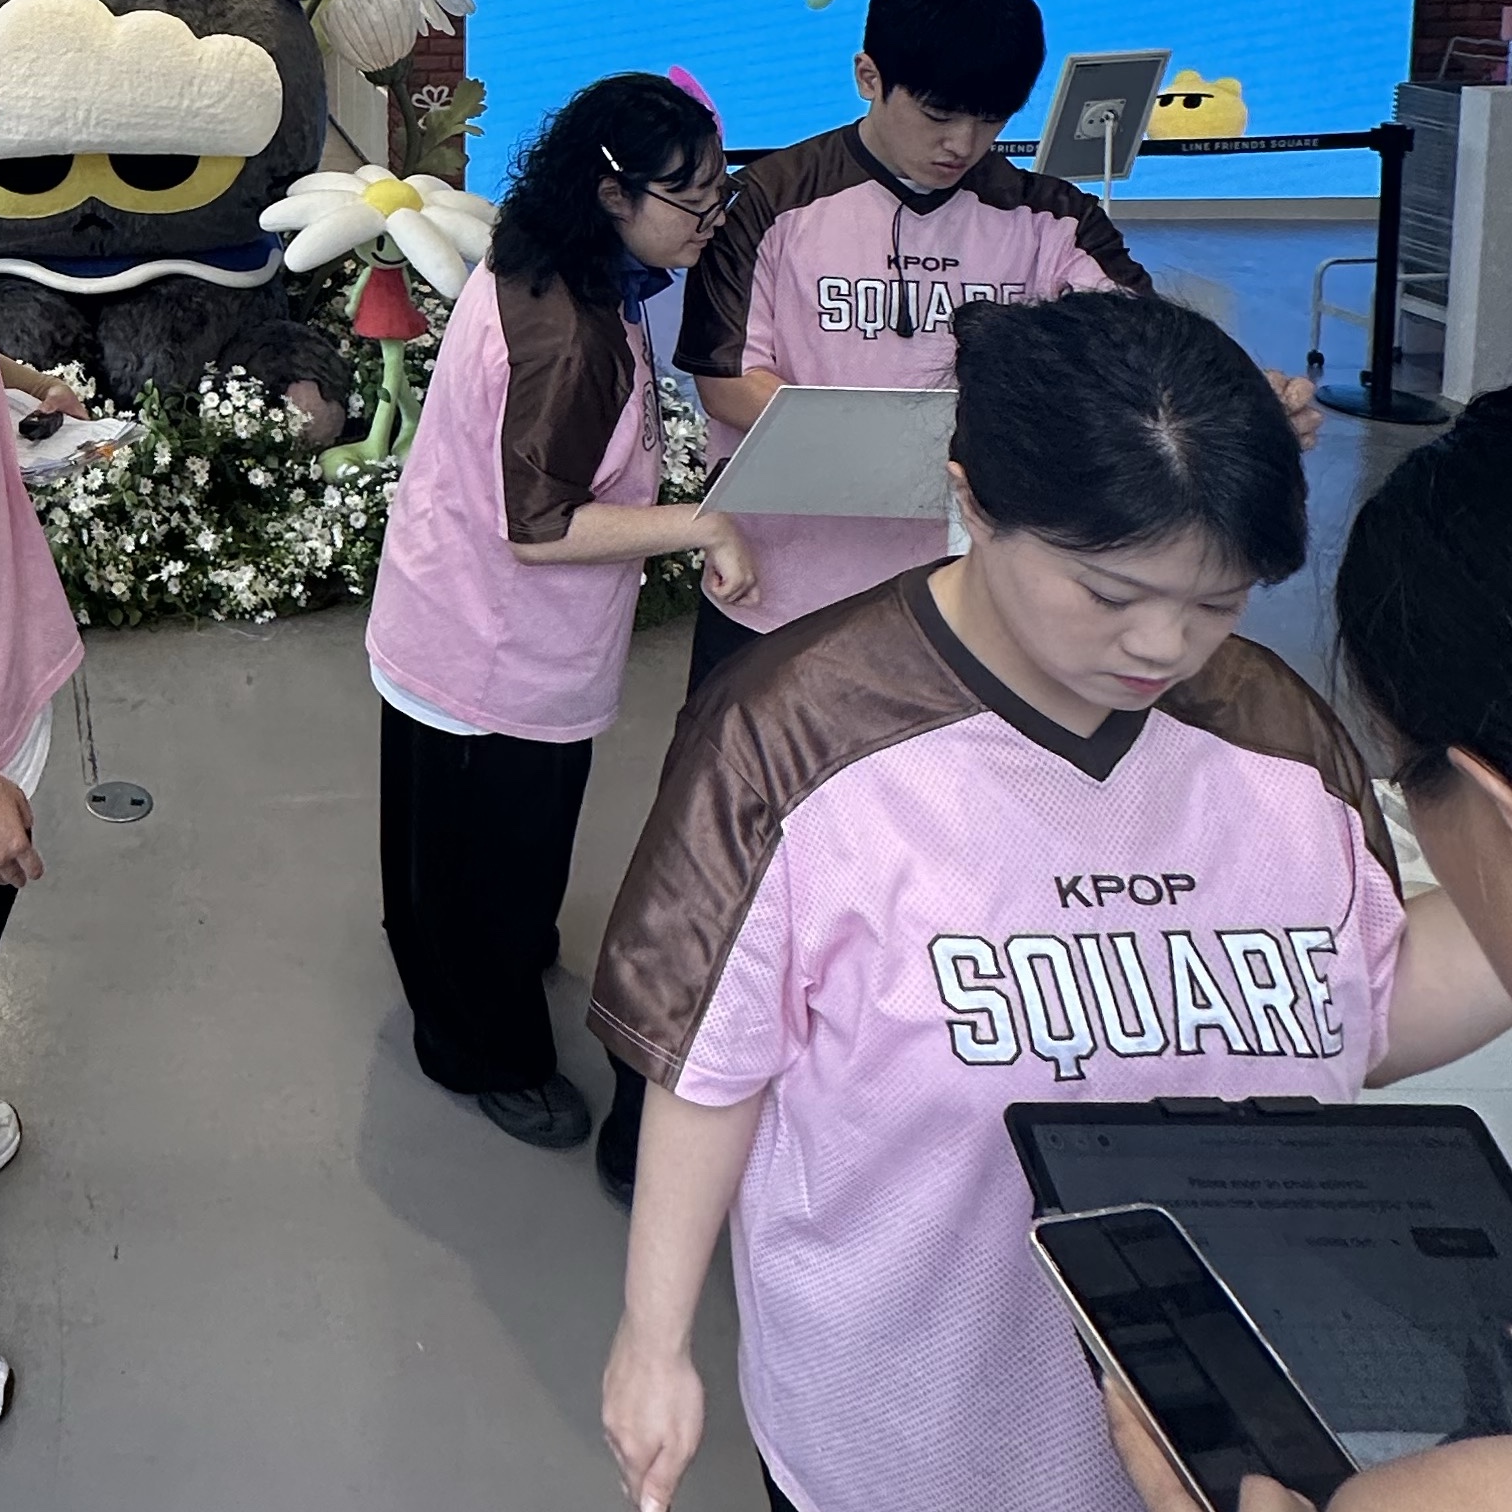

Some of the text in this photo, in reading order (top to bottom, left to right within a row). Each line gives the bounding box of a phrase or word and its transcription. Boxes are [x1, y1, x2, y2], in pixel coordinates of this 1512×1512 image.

[1181, 138, 1319, 152] LINE FRIENDS SQUARE
[887, 254, 959, 272] KPOP
[1054, 873, 1196, 908] KPOP
[927, 927, 1345, 1081] SQUARE
